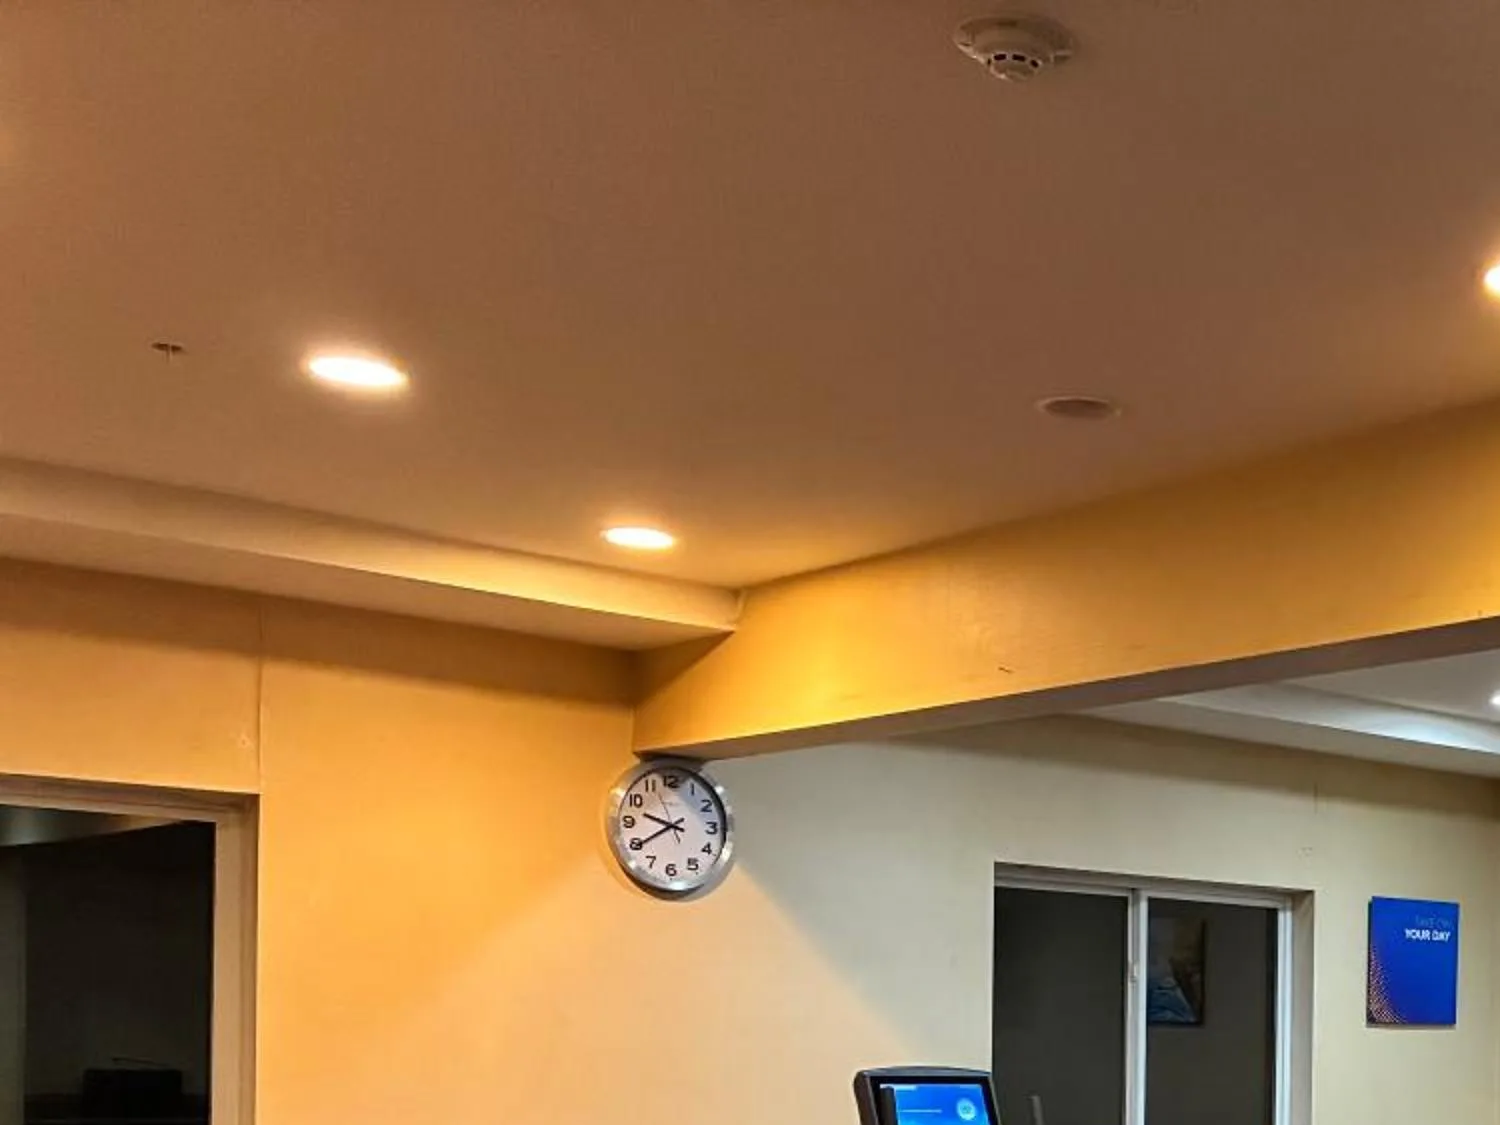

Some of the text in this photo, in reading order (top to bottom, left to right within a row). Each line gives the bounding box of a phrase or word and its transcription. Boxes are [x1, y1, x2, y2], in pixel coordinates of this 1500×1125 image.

[645, 779, 657, 792] 11
[663, 775, 680, 789] 12
[690, 783, 695, 796] 1
[629, 793, 643, 808] 10
[700, 799, 713, 813] 2
[623, 815, 636, 829] 9
[705, 821, 718, 835] 3
[629, 837, 643, 851] 8
[701, 841, 713, 855] 4
[645, 855, 657, 869] 7
[687, 857, 699, 871] 5
[665, 863, 677, 877] 6
[1404, 927, 1451, 943] YOUR DAY
